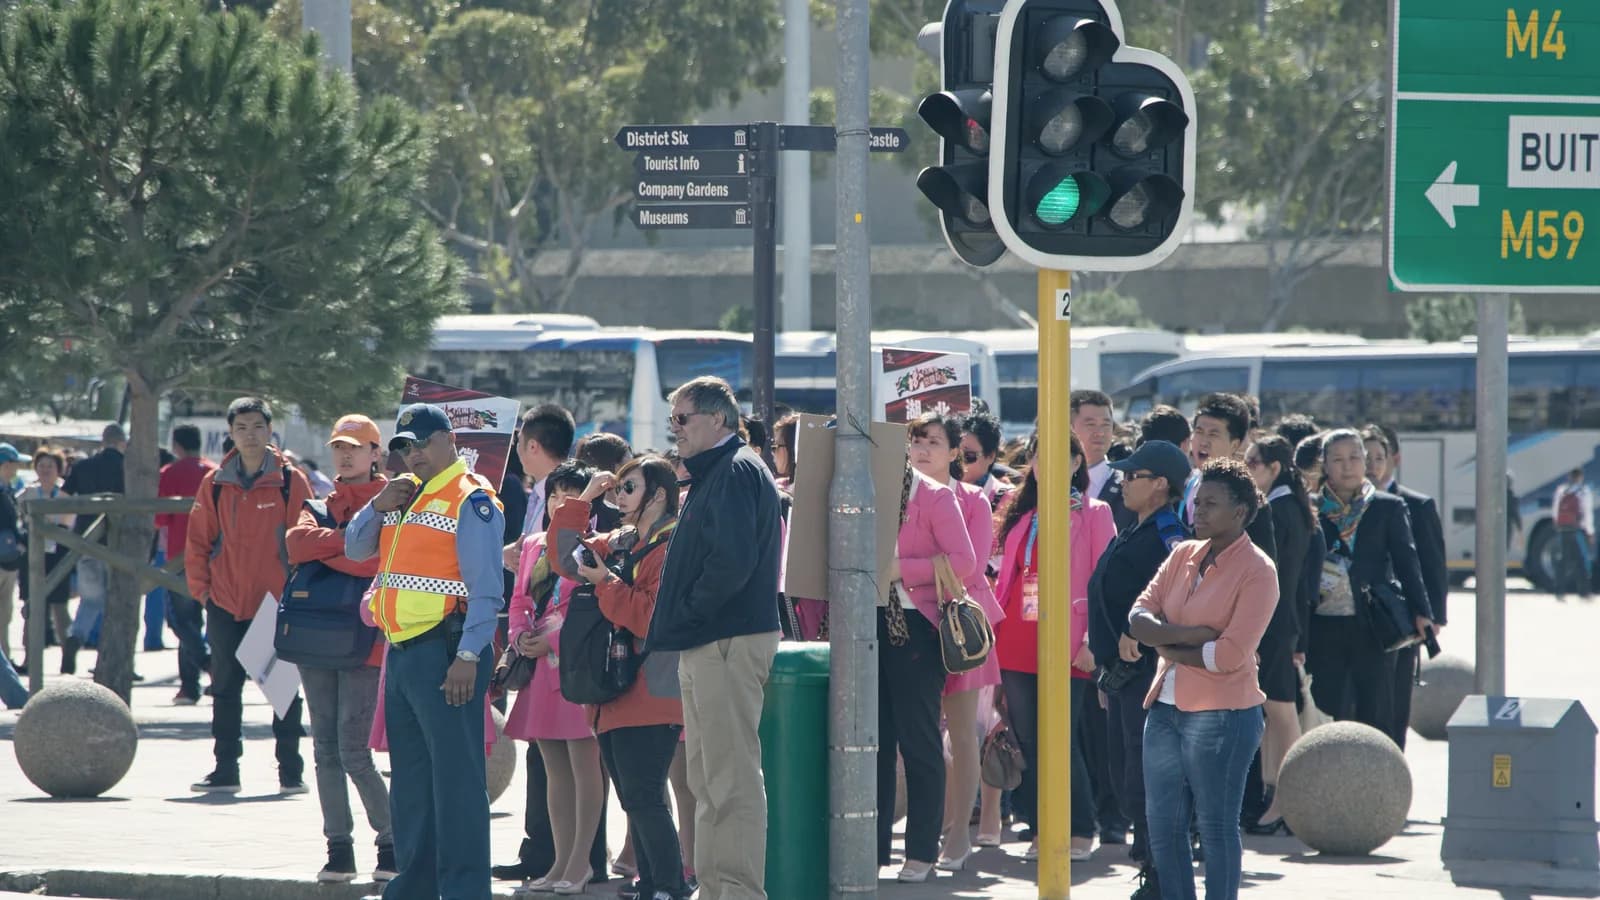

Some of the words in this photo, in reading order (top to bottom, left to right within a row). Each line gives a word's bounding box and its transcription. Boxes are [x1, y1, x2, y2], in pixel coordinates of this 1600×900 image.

[1505, 8, 1567, 60] M4
[627, 131, 670, 146] District
[671, 130, 689, 146] Six
[869, 132, 900, 148] astle
[1521, 132, 1600, 173] BUIT
[644, 155, 678, 170] Tourist
[680, 155, 700, 170] Info
[638, 181, 685, 200] Company
[686, 181, 729, 197] Gardens
[640, 209, 689, 225] Museums
[1500, 209, 1585, 260] M59
[1062, 291, 1071, 317] 2
[1501, 701, 1520, 718] 2
